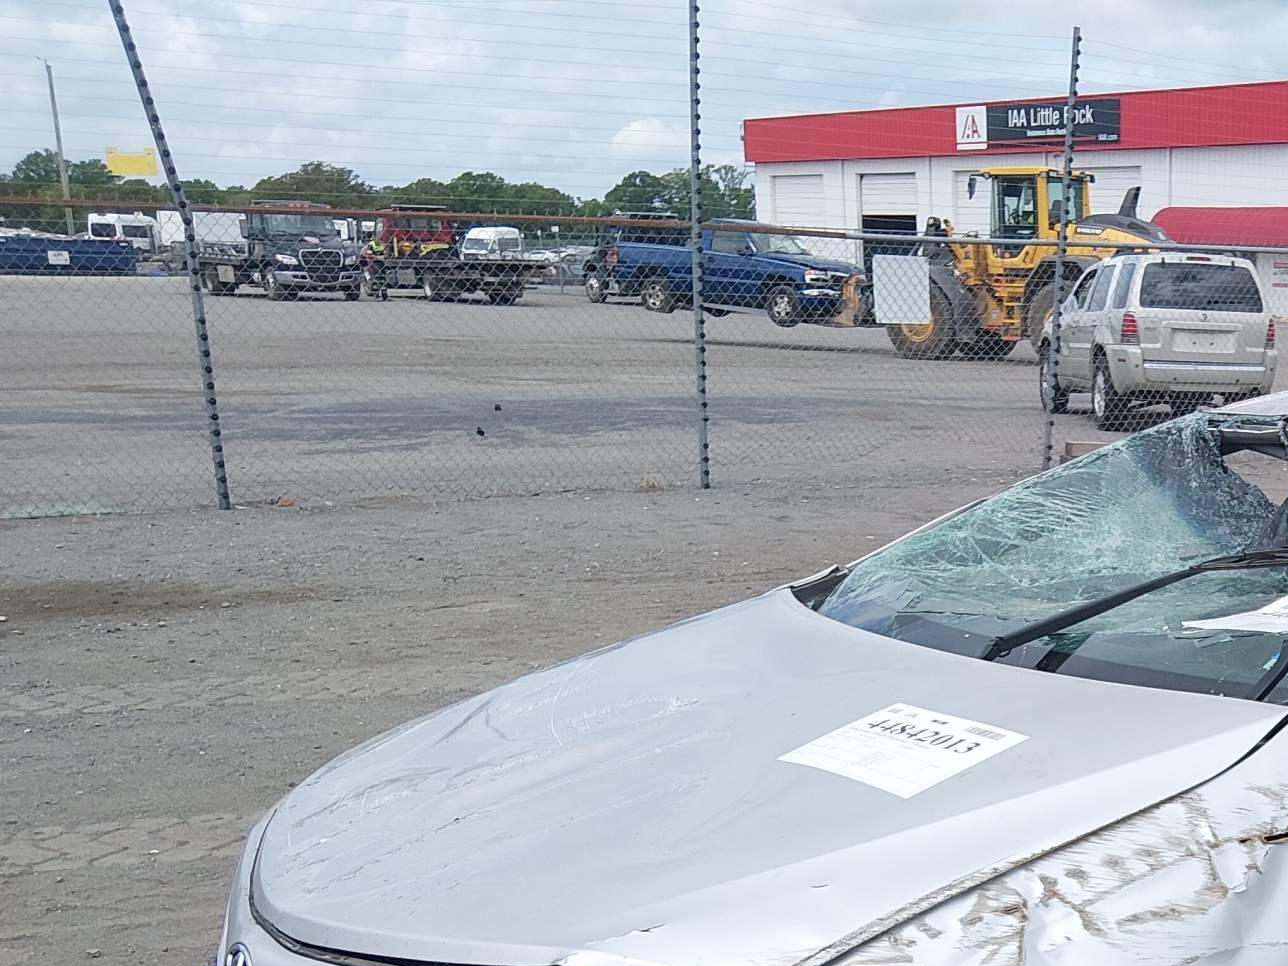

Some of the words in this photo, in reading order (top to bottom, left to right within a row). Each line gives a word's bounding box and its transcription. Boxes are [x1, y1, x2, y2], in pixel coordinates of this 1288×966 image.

[1007, 108, 1028, 128] IAA
[1030, 106, 1060, 127] Little
[867, 718, 982, 754] 44842013
